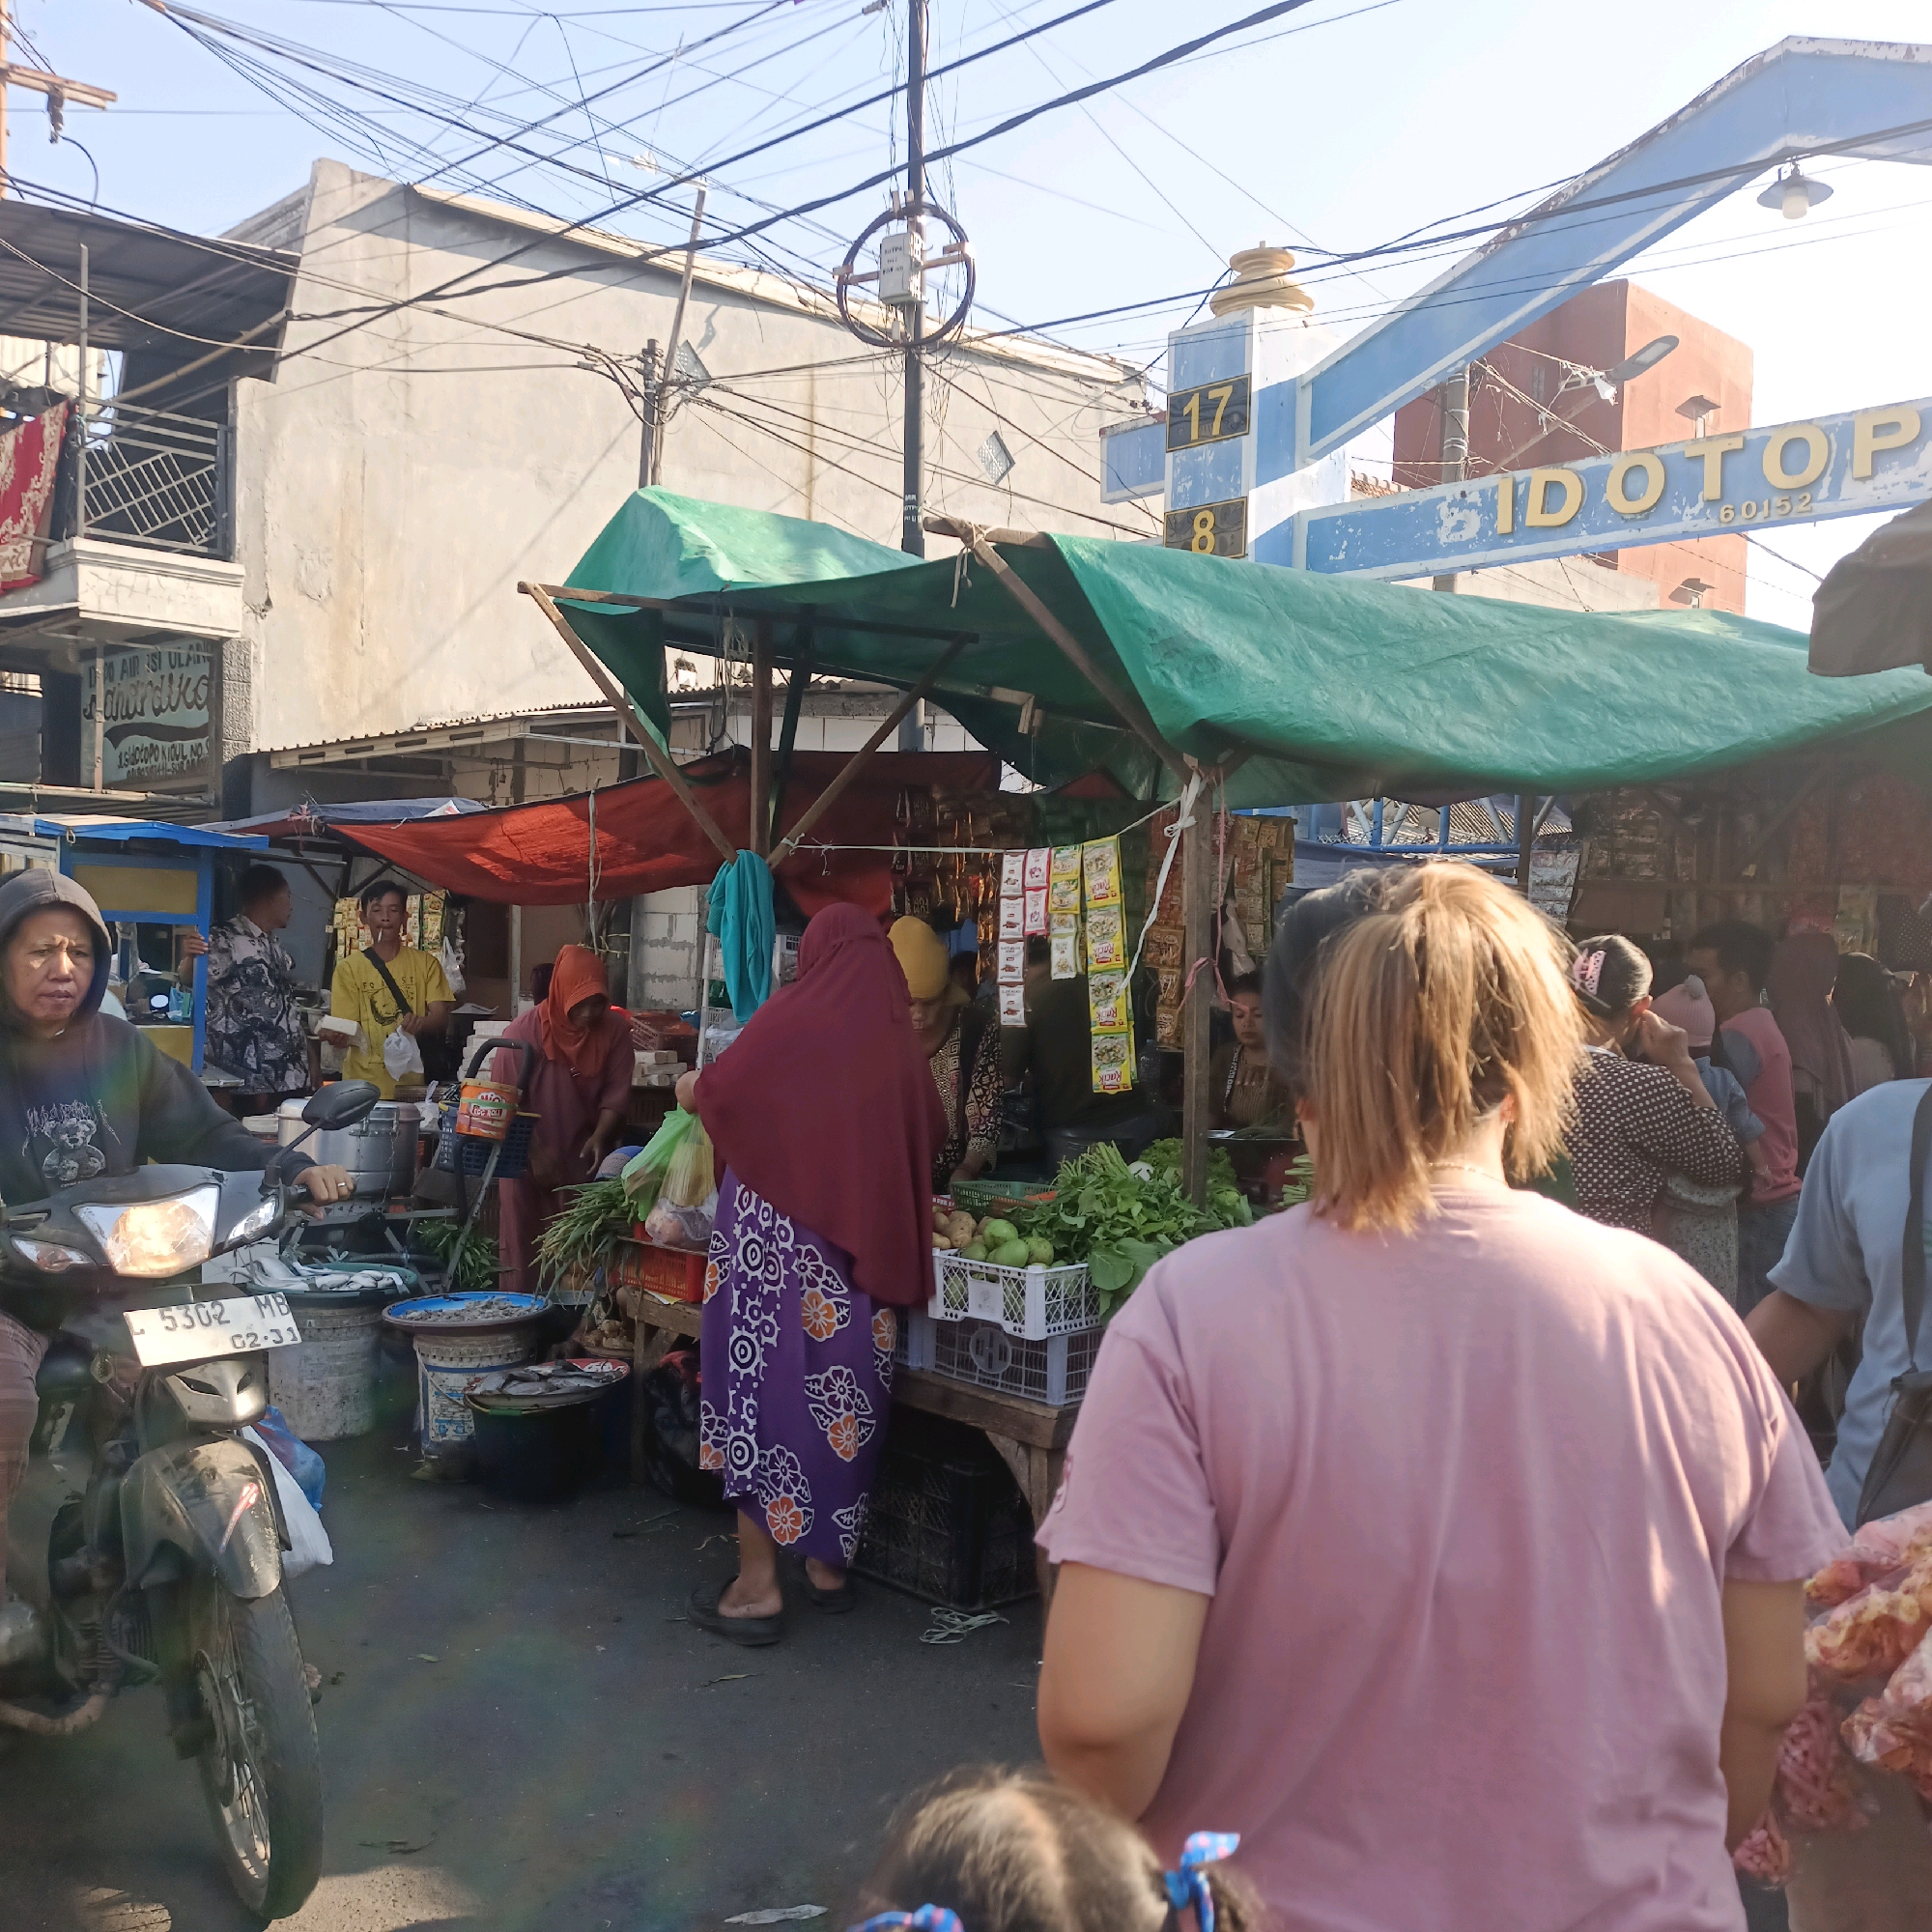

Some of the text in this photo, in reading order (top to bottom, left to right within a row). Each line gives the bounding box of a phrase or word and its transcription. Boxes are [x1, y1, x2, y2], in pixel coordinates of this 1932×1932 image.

[1182, 384, 1234, 442] 17
[1719, 492, 1813, 524] 60152
[1190, 509, 1216, 554] 8
[120, 655, 139, 681] AIR
[1095, 1007, 1118, 1021] Racik
[1098, 1070, 1122, 1086] Racik
[158, 1300, 231, 1332] 5302
[253, 1293, 291, 1320] MB
